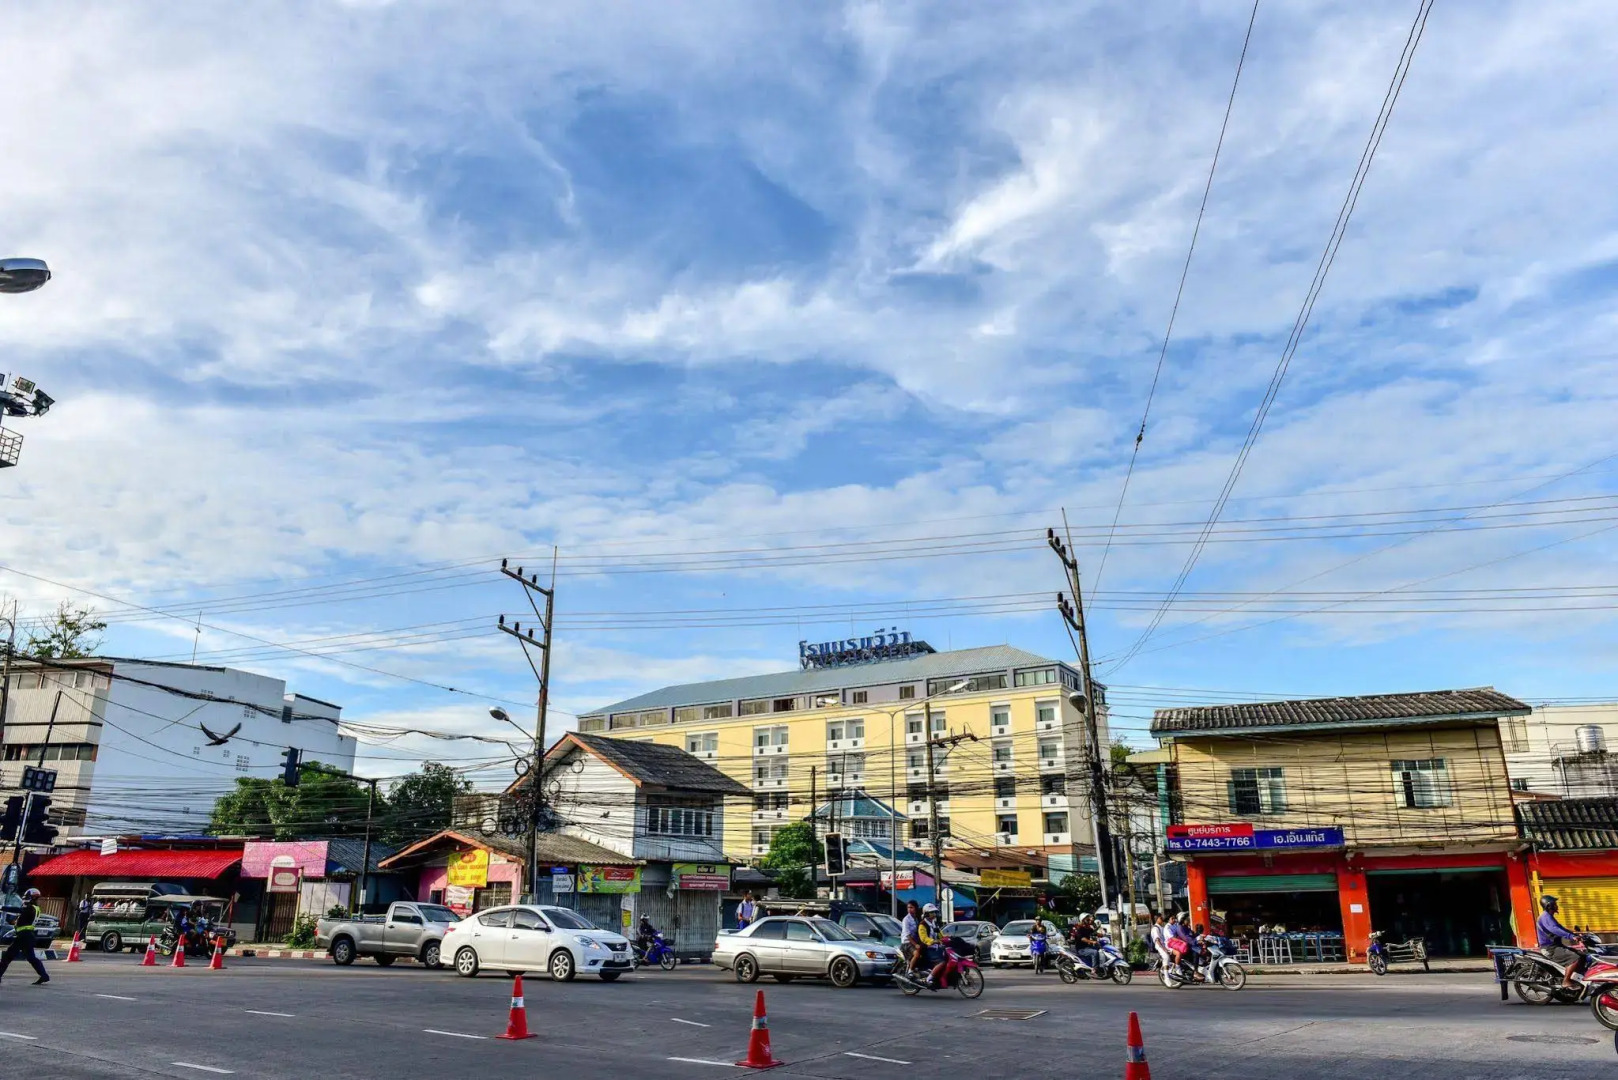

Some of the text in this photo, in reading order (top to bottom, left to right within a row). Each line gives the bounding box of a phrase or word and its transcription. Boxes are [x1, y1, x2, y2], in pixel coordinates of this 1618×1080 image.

[1187, 824, 1231, 836] ศูนย์บริการ
[1184, 836, 1250, 848] 0-7443-7766
